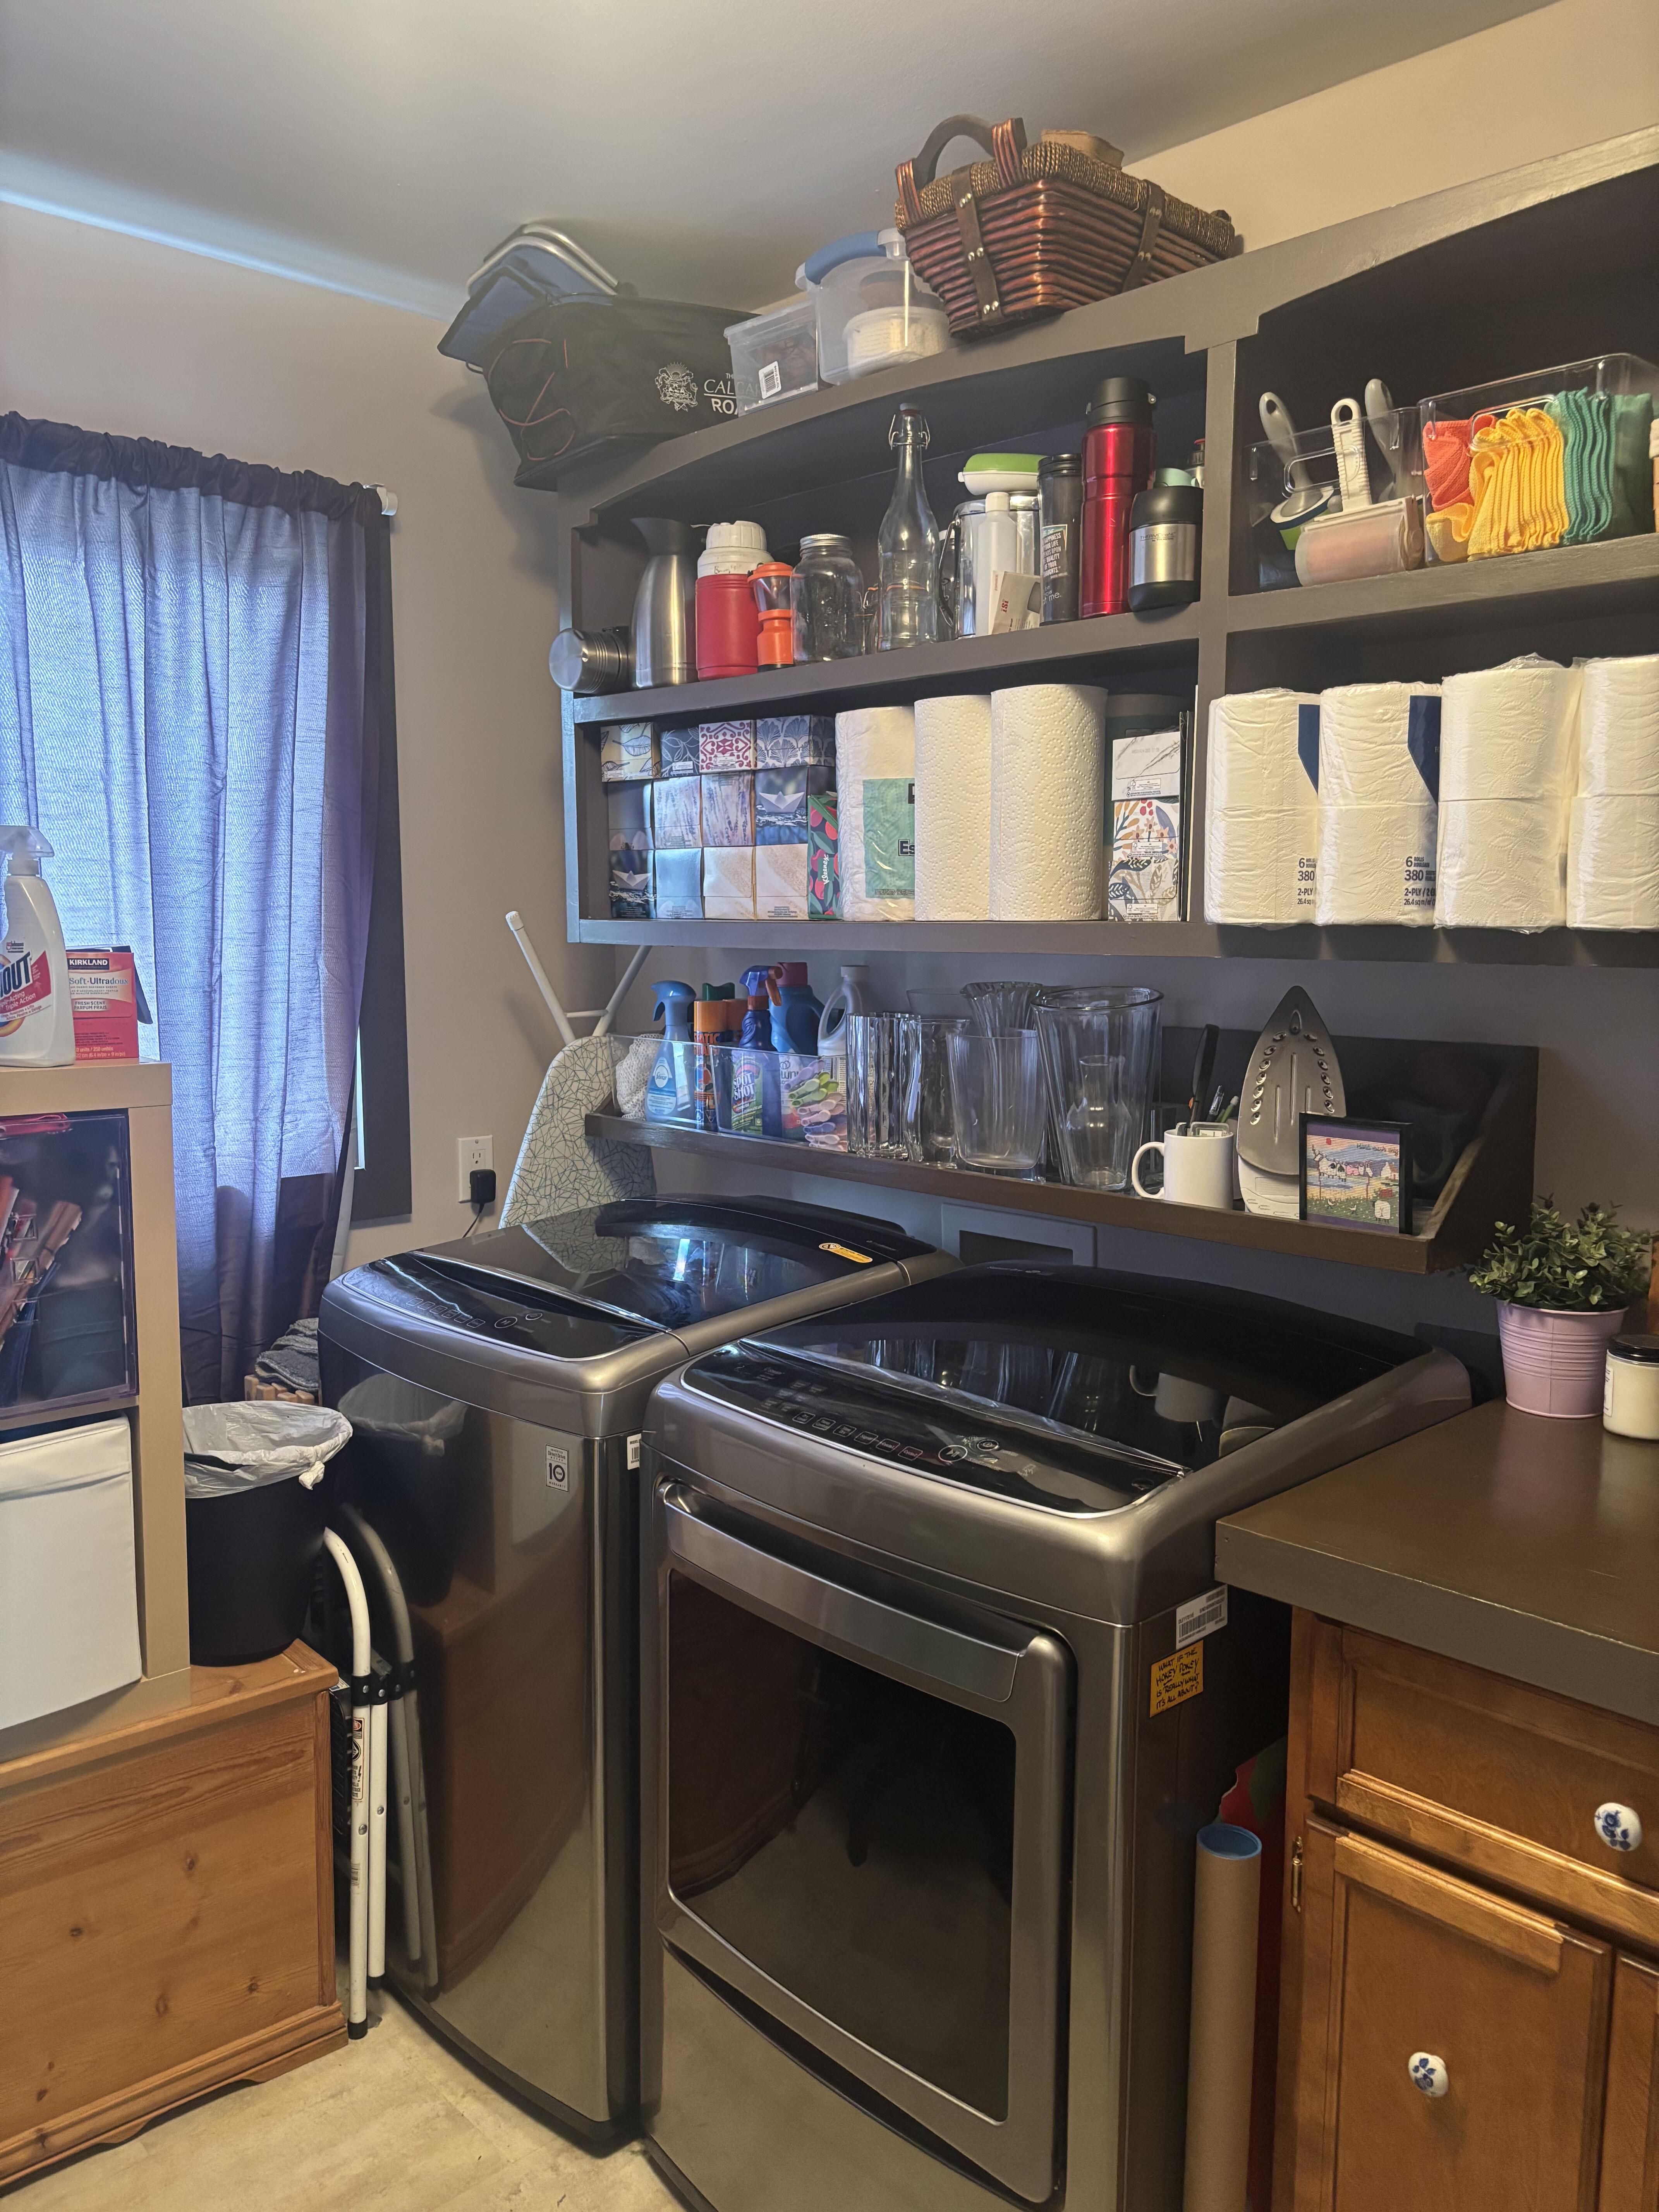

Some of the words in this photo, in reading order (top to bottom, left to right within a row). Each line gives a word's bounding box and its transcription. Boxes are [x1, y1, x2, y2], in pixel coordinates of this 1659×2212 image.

[898, 840, 915, 856] Es
[821, 854, 830, 885] Kleenex
[1299, 858, 1305, 868] 6
[1406, 856, 1413, 867] 6
[1298, 871, 1315, 881] 380
[1404, 870, 1424, 881] 380
[1404, 888, 1422, 896] 2-PLY
[5, 1001, 18, 1011] Triple
[19, 993, 36, 1005] Action
[733, 1072, 752, 1090] SPOT
[734, 1083, 755, 1100] SHOT
[549, 1463, 565, 1482] 10
[1159, 1658, 1175, 1671] WHAT
[1177, 1654, 1183, 1662] IF
[1185, 1647, 1198, 1658] THE
[1156, 1665, 1178, 1686] HOKEY
[1179, 1657, 1199, 1673] POKEY
[1156, 1690, 1162, 1698] IS
[1163, 1678, 1185, 1693] REALLY
[1185, 1673, 1199, 1685] WHAT
[1156, 1697, 1165, 1710] IT'S
